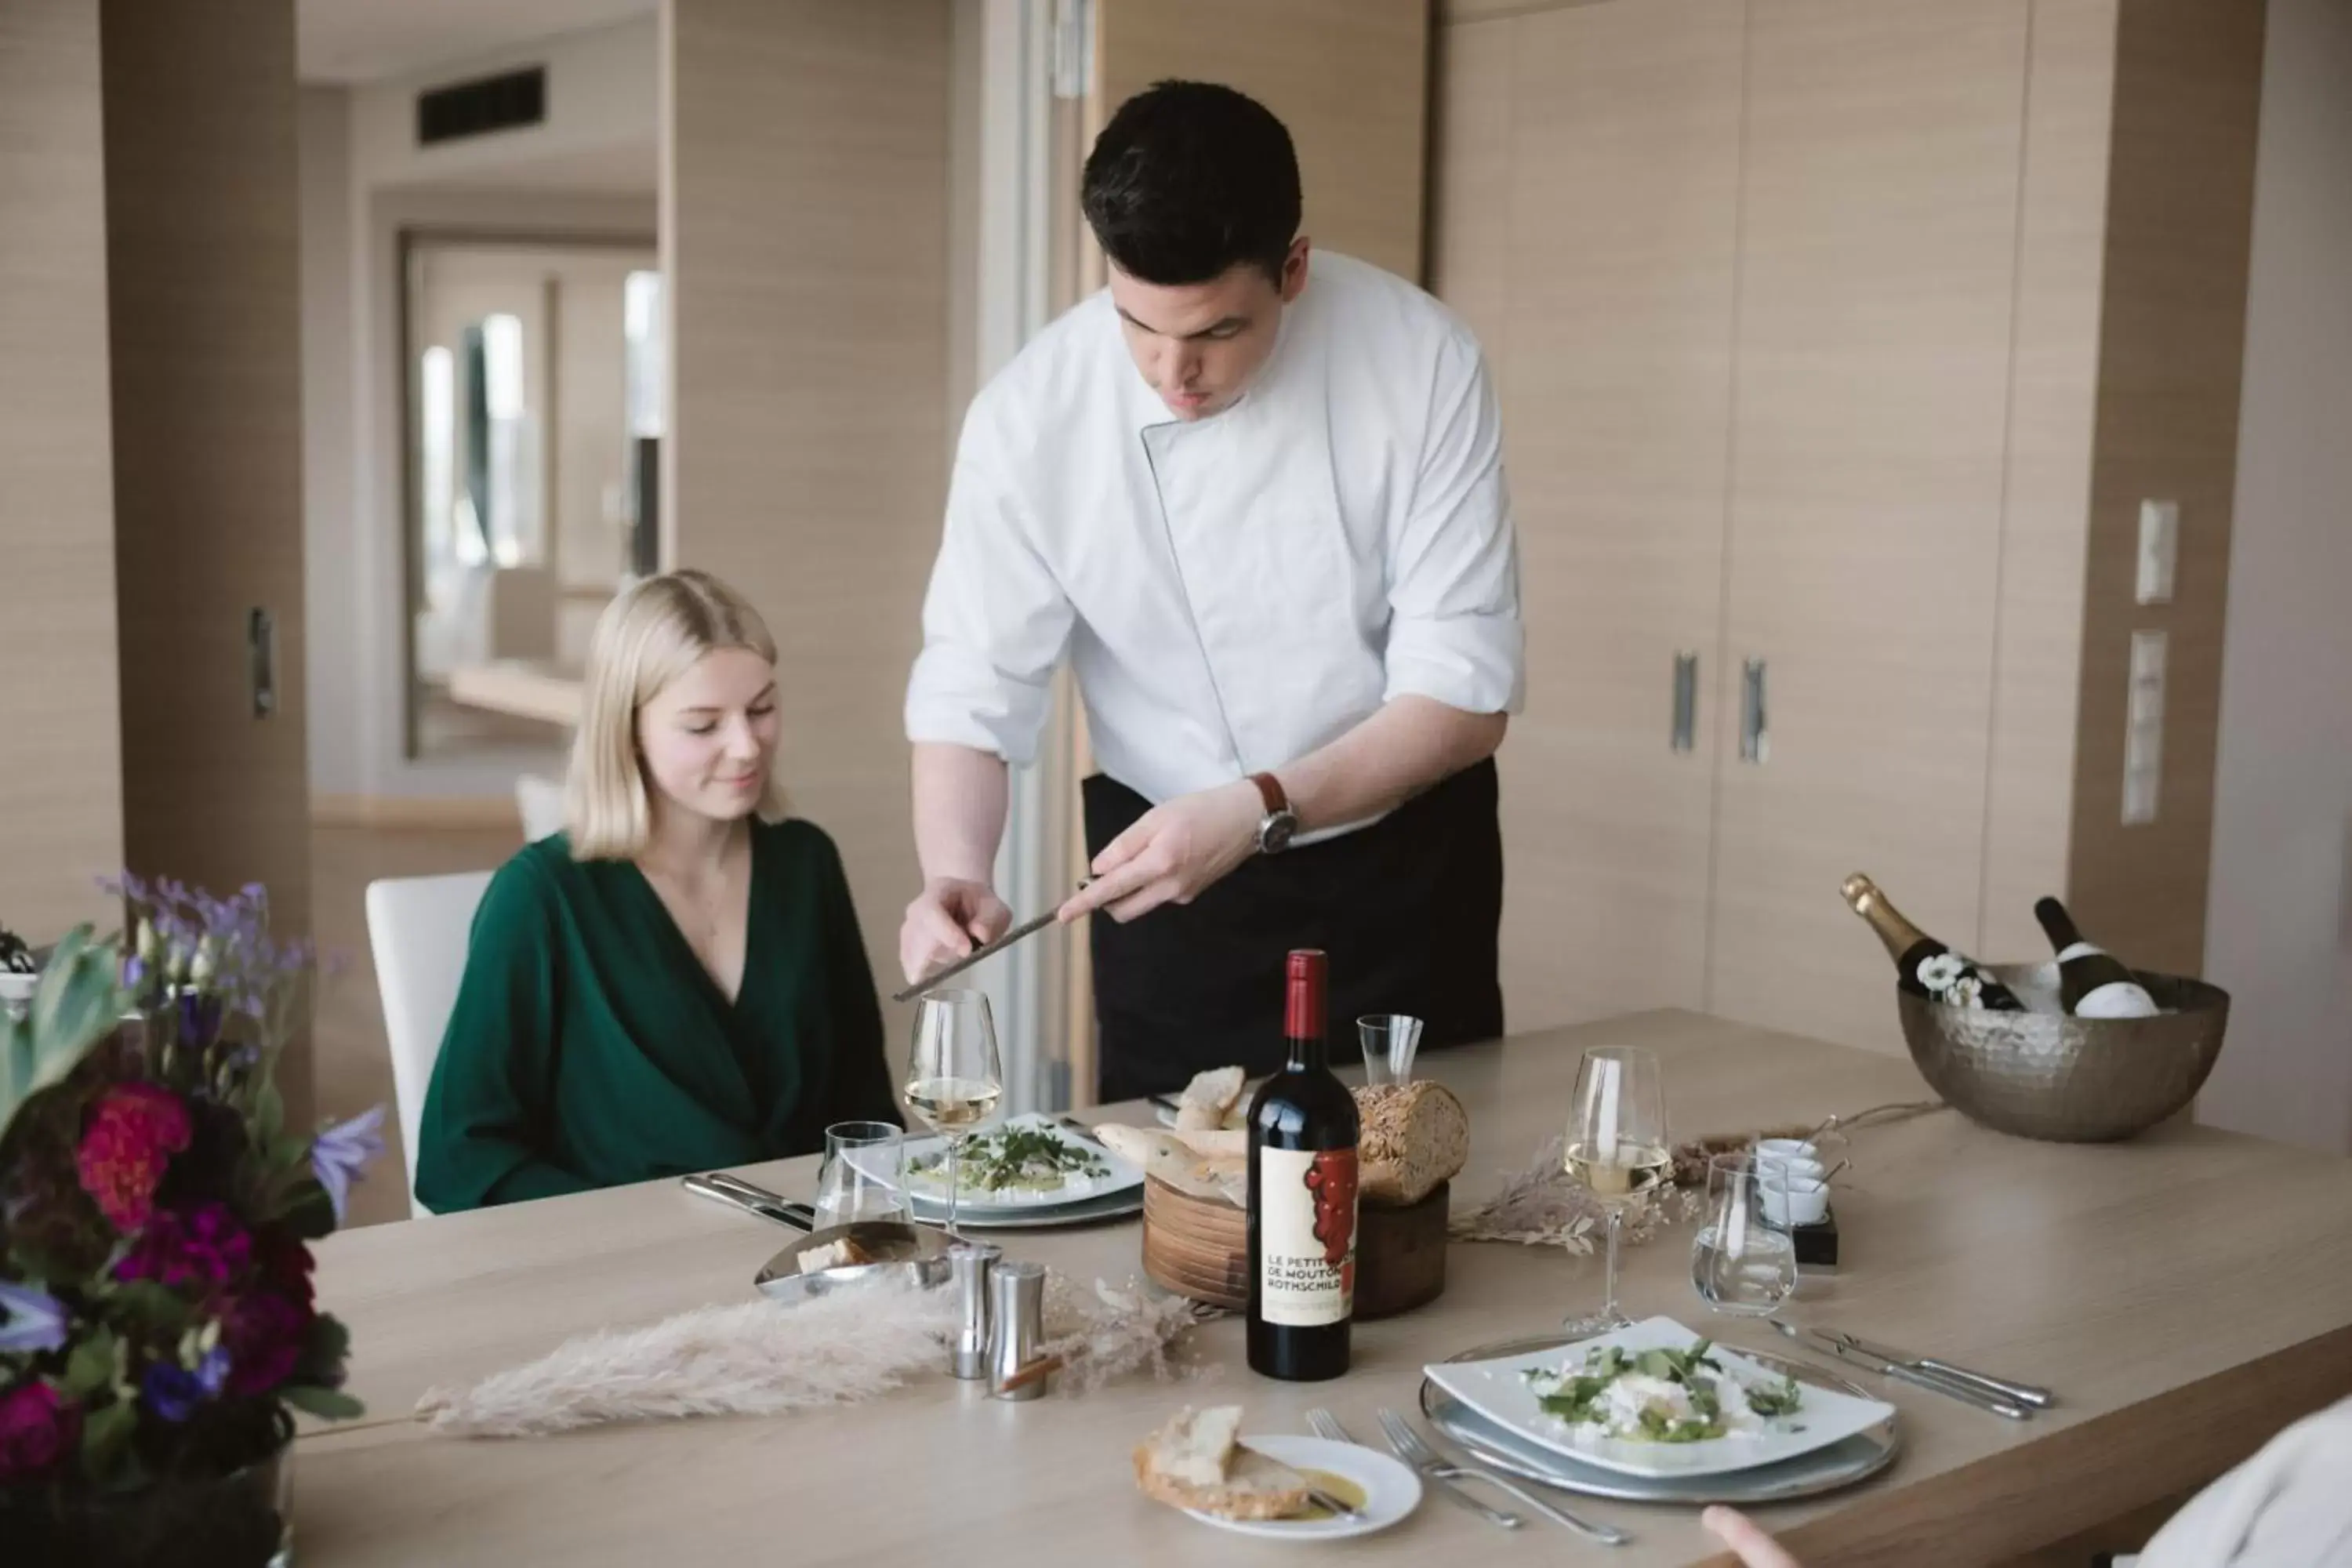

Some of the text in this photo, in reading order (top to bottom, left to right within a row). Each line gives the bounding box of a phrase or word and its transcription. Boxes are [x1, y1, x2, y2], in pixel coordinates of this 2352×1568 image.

[1268, 1254, 1283, 1266] LE
[1287, 1256, 1325, 1268] PETIT
[1268, 1266, 1341, 1279] DE MOUTON
[1268, 1279, 1341, 1291] ROTHSCHILD
